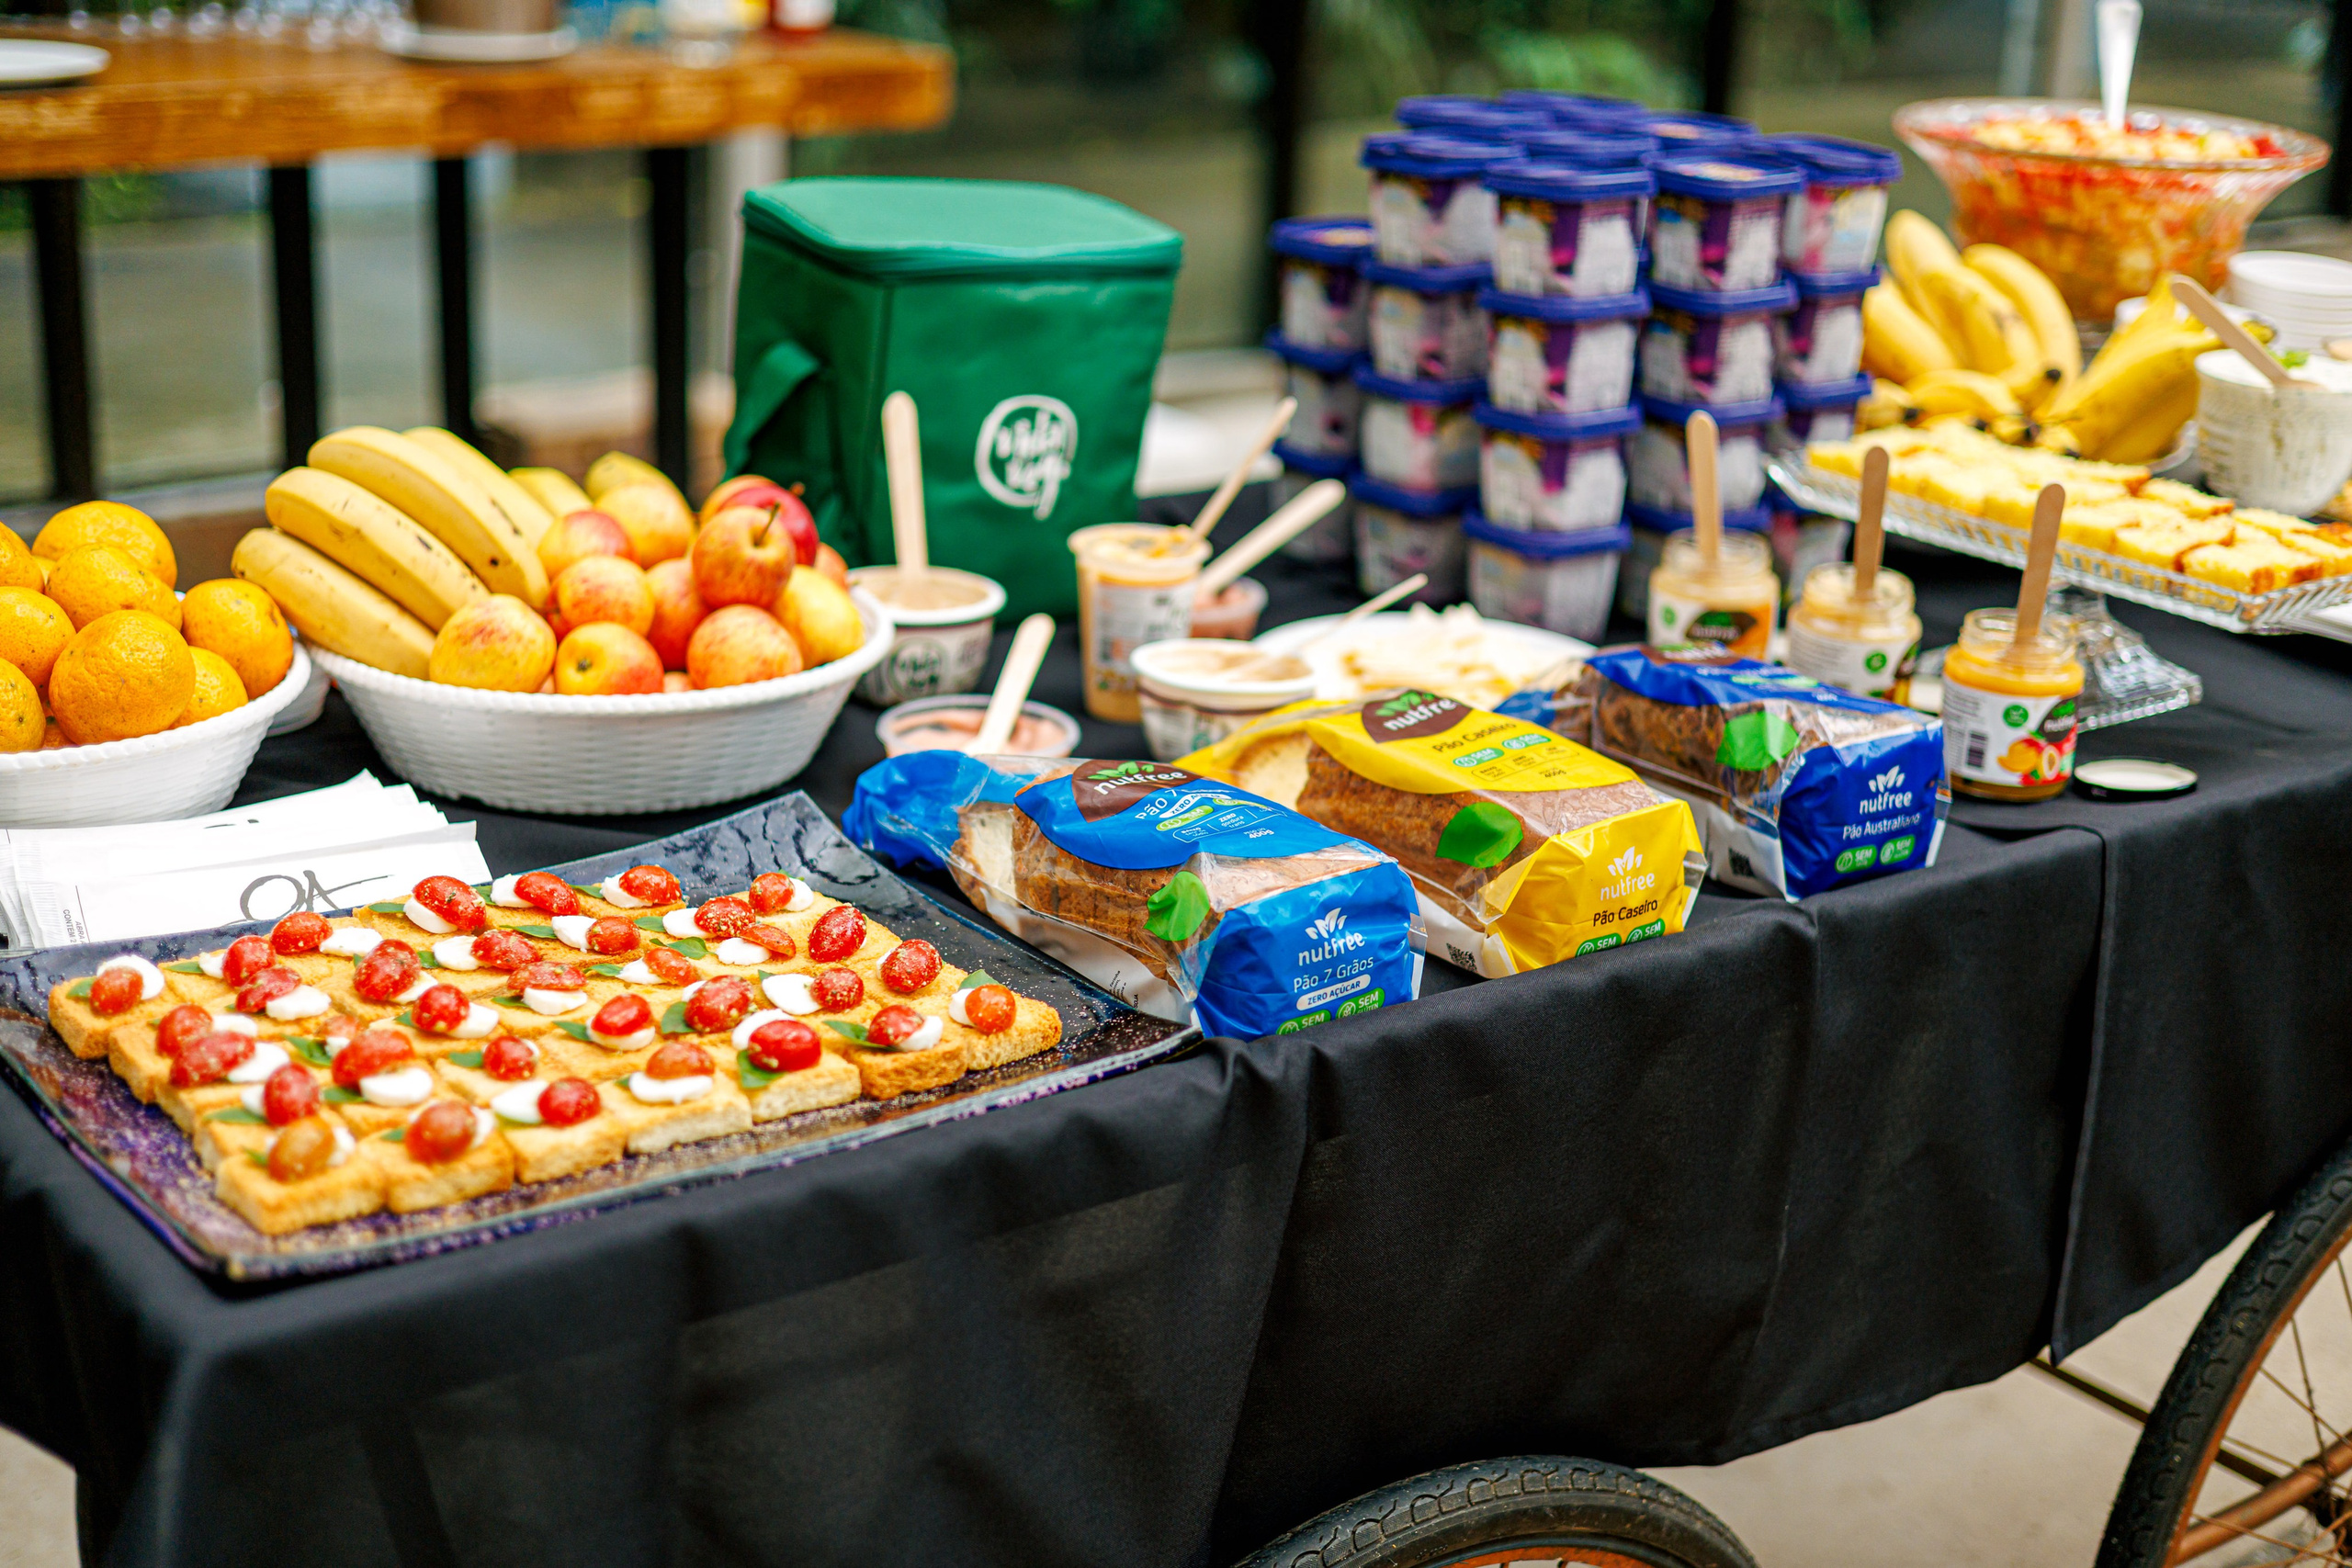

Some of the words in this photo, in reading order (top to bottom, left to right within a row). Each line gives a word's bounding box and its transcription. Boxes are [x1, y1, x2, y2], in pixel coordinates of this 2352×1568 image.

[1383, 699, 1461, 731] nutfre
[1432, 740, 1464, 752] Pão
[1463, 723, 1517, 742] Caseiro
[1093, 772, 1187, 795] nutfree
[1135, 797, 1168, 819] Pão
[1170, 799, 1191, 815] ZERO
[1859, 791, 1913, 815] nutfree
[1218, 812, 1237, 823] ZERO
[1842, 823, 1862, 840] Pão
[1863, 812, 1921, 836] Australiano
[1249, 829, 1275, 839] 400g
[1855, 848, 1873, 861] SEM
[1600, 873, 1656, 901] nutfree
[1592, 909, 1615, 927] Pão
[1618, 899, 1658, 920] Caseiro
[1645, 921, 1661, 937] SEM
[1298, 932, 1365, 966] nutfree
[1597, 936, 1617, 951] SEM
[1293, 974, 1319, 994] Pão
[1323, 968, 1333, 984] 7
[1336, 956, 1374, 979] Grãos
[1307, 992, 1328, 1006] ZERO
[1329, 980, 1361, 998] AÇÚCAR
[1358, 990, 1379, 1009] SEM
[1301, 1012, 1325, 1029] SEM
